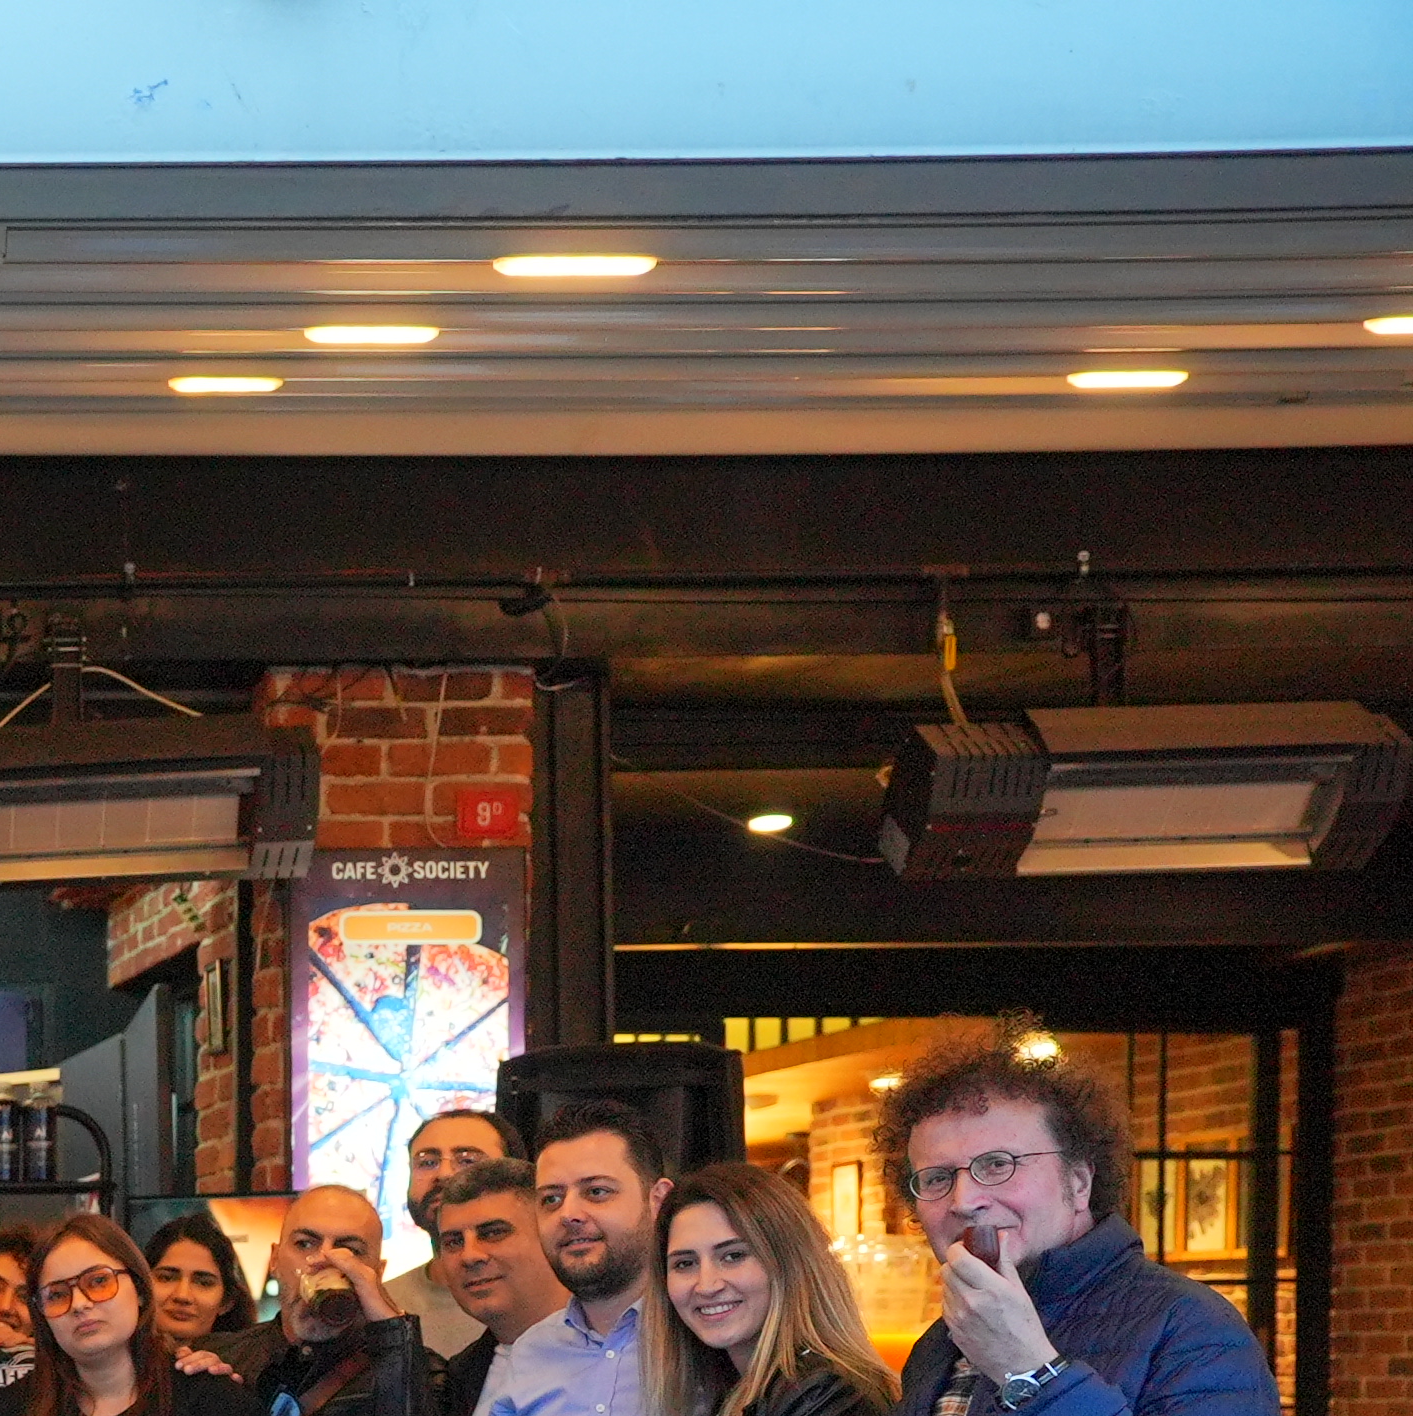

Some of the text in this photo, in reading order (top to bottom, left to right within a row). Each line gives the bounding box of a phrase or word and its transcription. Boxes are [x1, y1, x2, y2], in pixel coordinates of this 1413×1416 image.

[331, 859, 491, 881] CAFE SOCIETY
[386, 921, 434, 934] PIZZA
